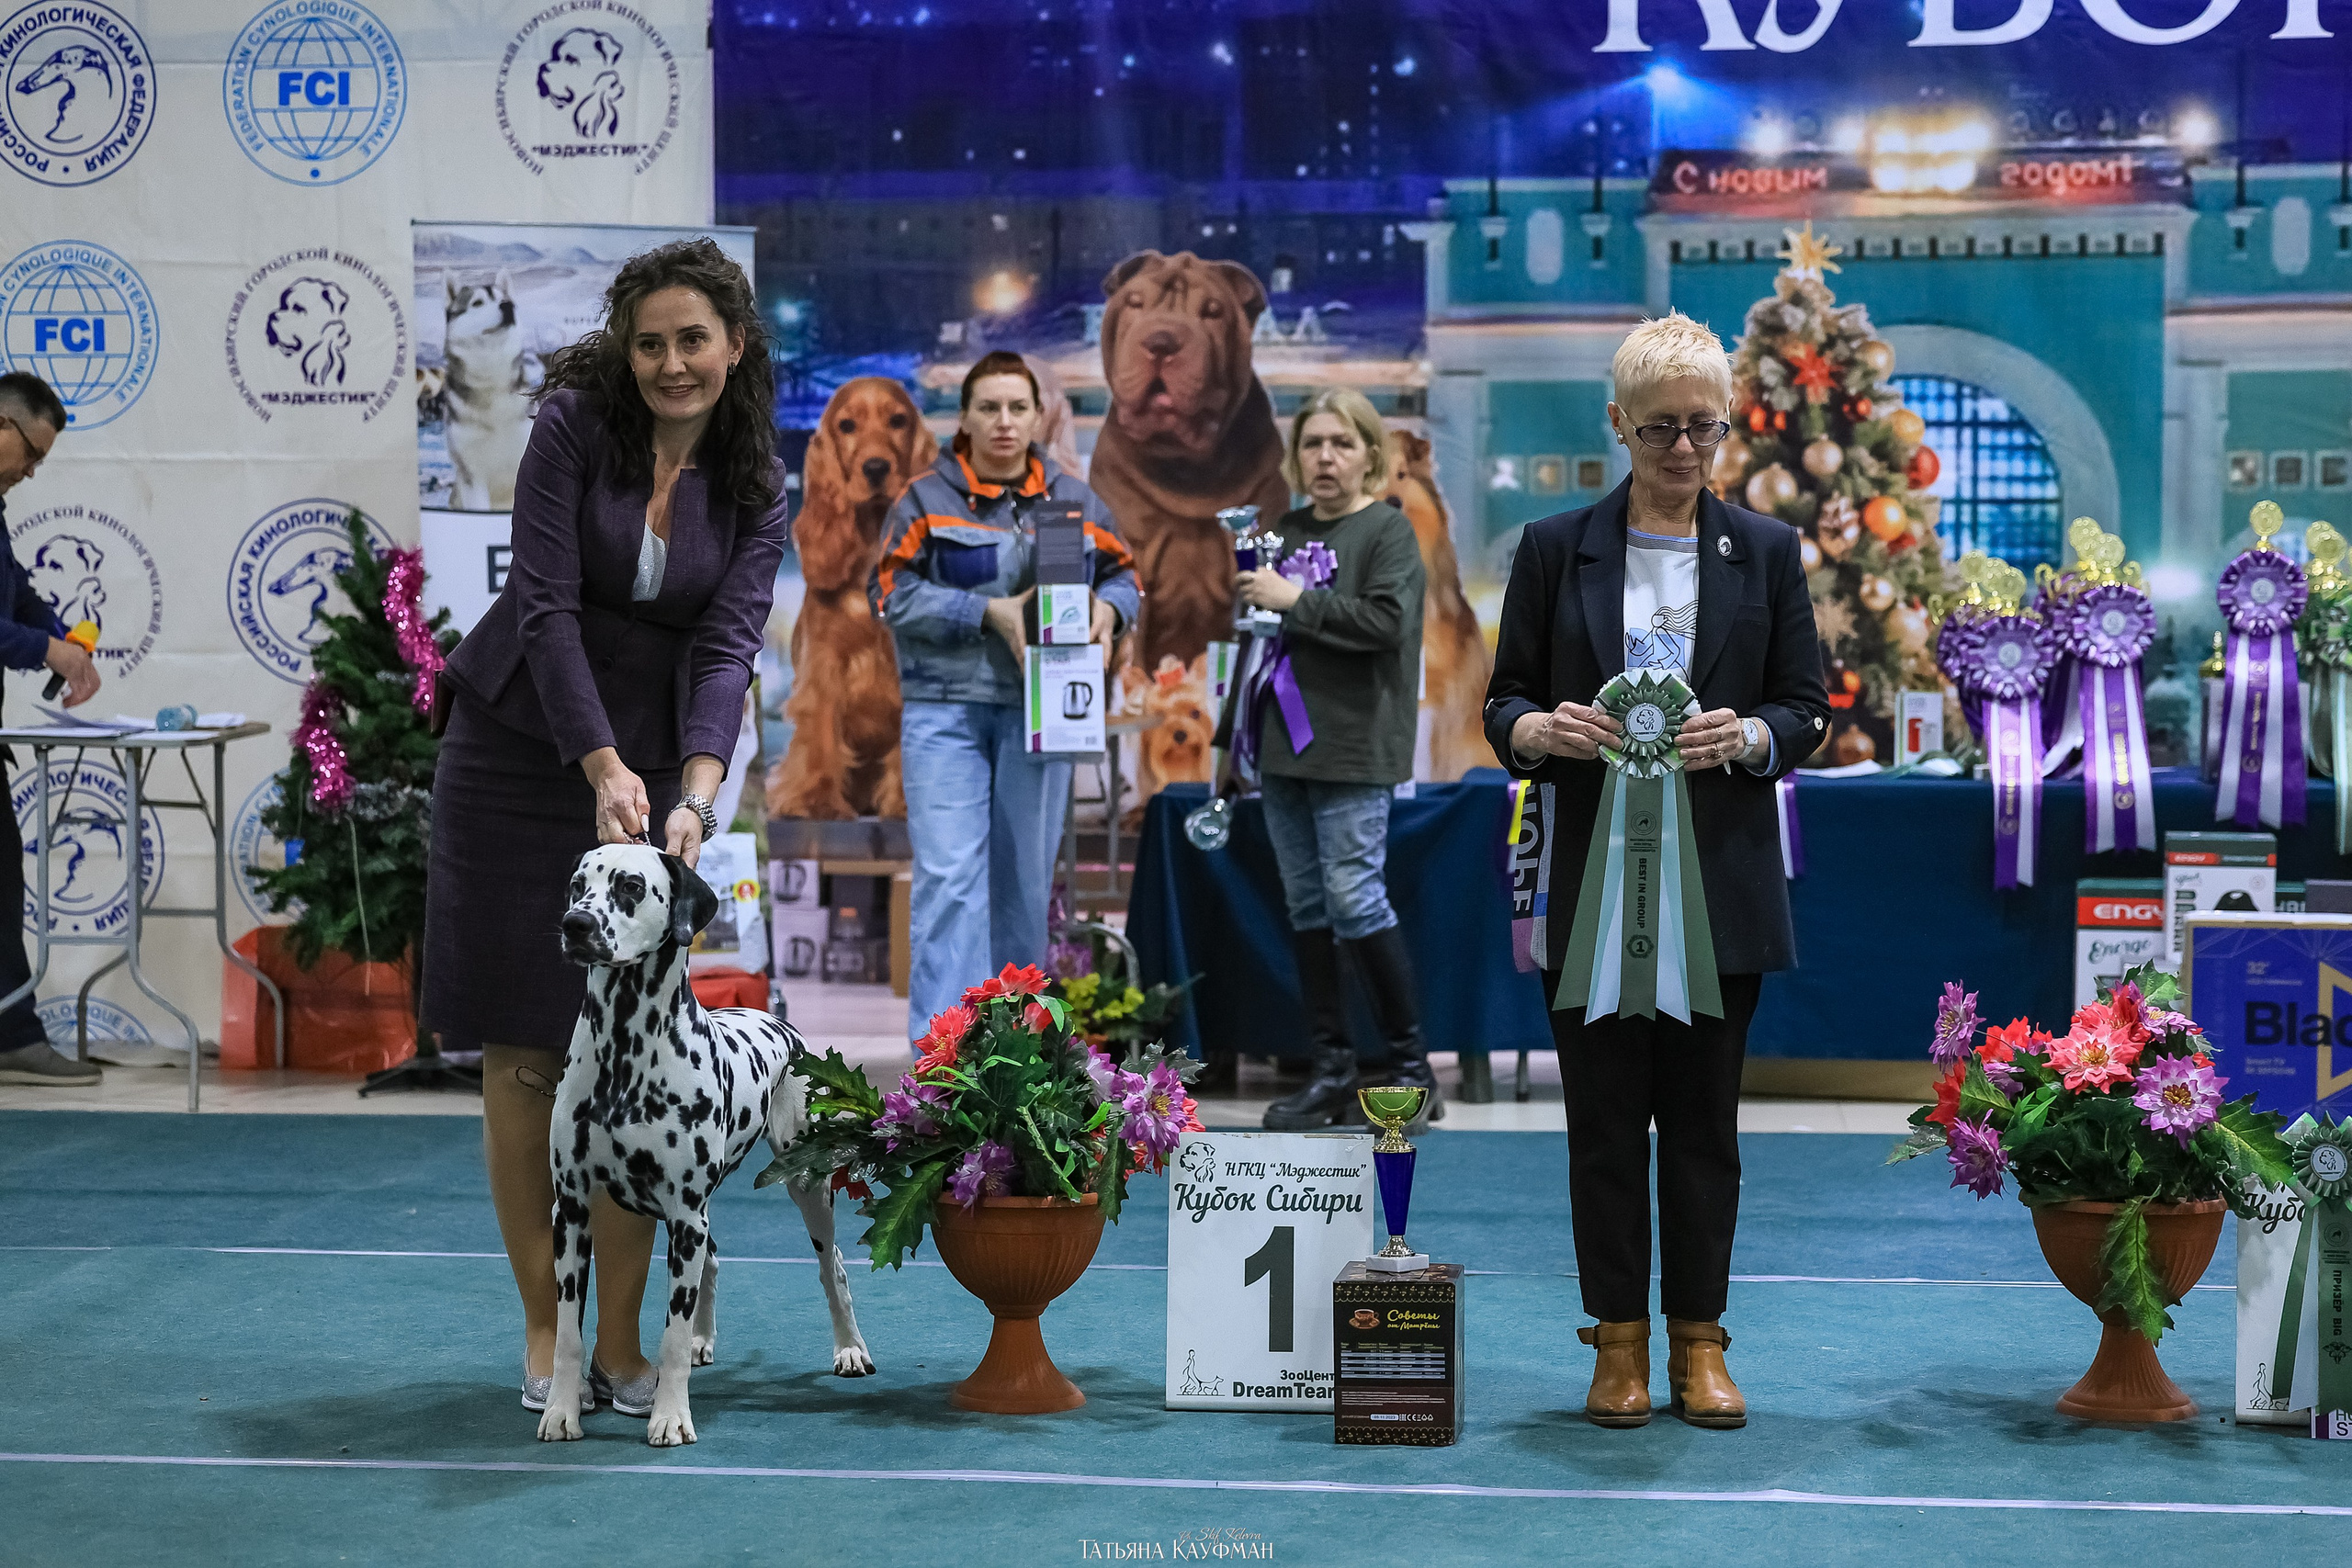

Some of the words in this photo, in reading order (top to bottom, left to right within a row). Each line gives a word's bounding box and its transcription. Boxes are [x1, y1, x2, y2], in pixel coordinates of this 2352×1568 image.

[247, 1, 360, 46] CYNOLOGIQUE
[0, 7, 142, 69] КИНОЛОГИЧЕСКАЯ
[85, 73, 146, 173] ФЕДЕРАЦИЯ
[232, 47, 265, 152] FEDERATION
[278, 71, 350, 107] FCI
[359, 22, 400, 158] INTERNATIONALE
[4, 247, 114, 292] CYNOLOGIQUE
[113, 267, 153, 403] INTERNATIONALE
[34, 318, 106, 353] FCI
[9, 505, 85, 543] ОРОДСКОЙ
[237, 561, 301, 672] РОССИЙСКАЯ
[1637, 857, 1647, 882] BEST
[1637, 883, 1646, 893] IN
[1636, 895, 1646, 930] GROUP
[1635, 941, 1645, 953] 1
[1225, 1161, 1266, 1179] НГКЦ
[1270, 1162, 1367, 1183] "Мэджестик"
[1173, 1182, 1257, 1224] Кубок
[1265, 1184, 1363, 1224] Сибири
[1244, 1225, 1295, 1353] 1
[1387, 1309, 1441, 1322] Советы
[2333, 1316, 2343, 1337] BIG
